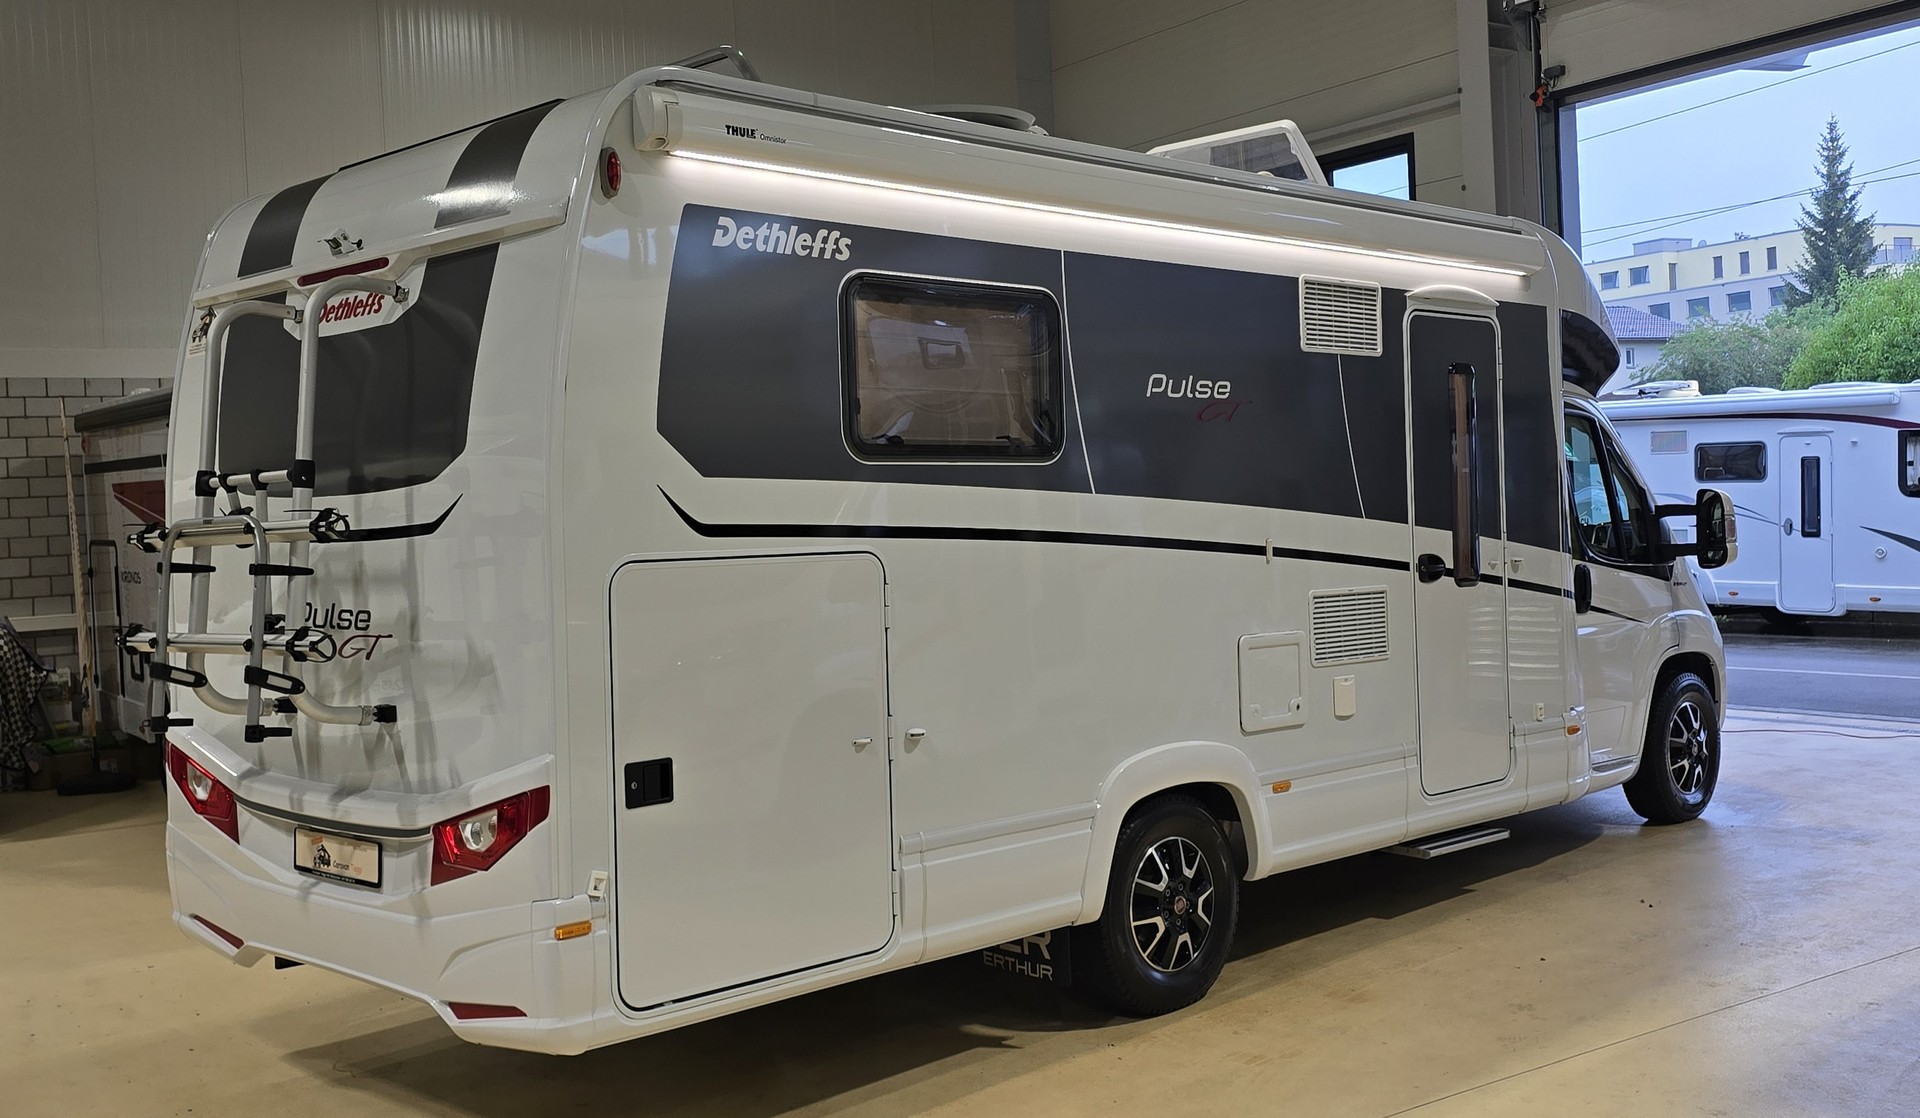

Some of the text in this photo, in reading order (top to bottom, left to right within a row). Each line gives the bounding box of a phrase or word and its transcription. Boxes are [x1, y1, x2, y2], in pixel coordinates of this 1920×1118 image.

[724, 124, 787, 144] THULE Omnistor
[712, 216, 852, 261] Dethleffs
[1146, 373, 1232, 399] Pulse
[337, 634, 393, 660] GT
[983, 950, 1053, 981] ERTHUR
